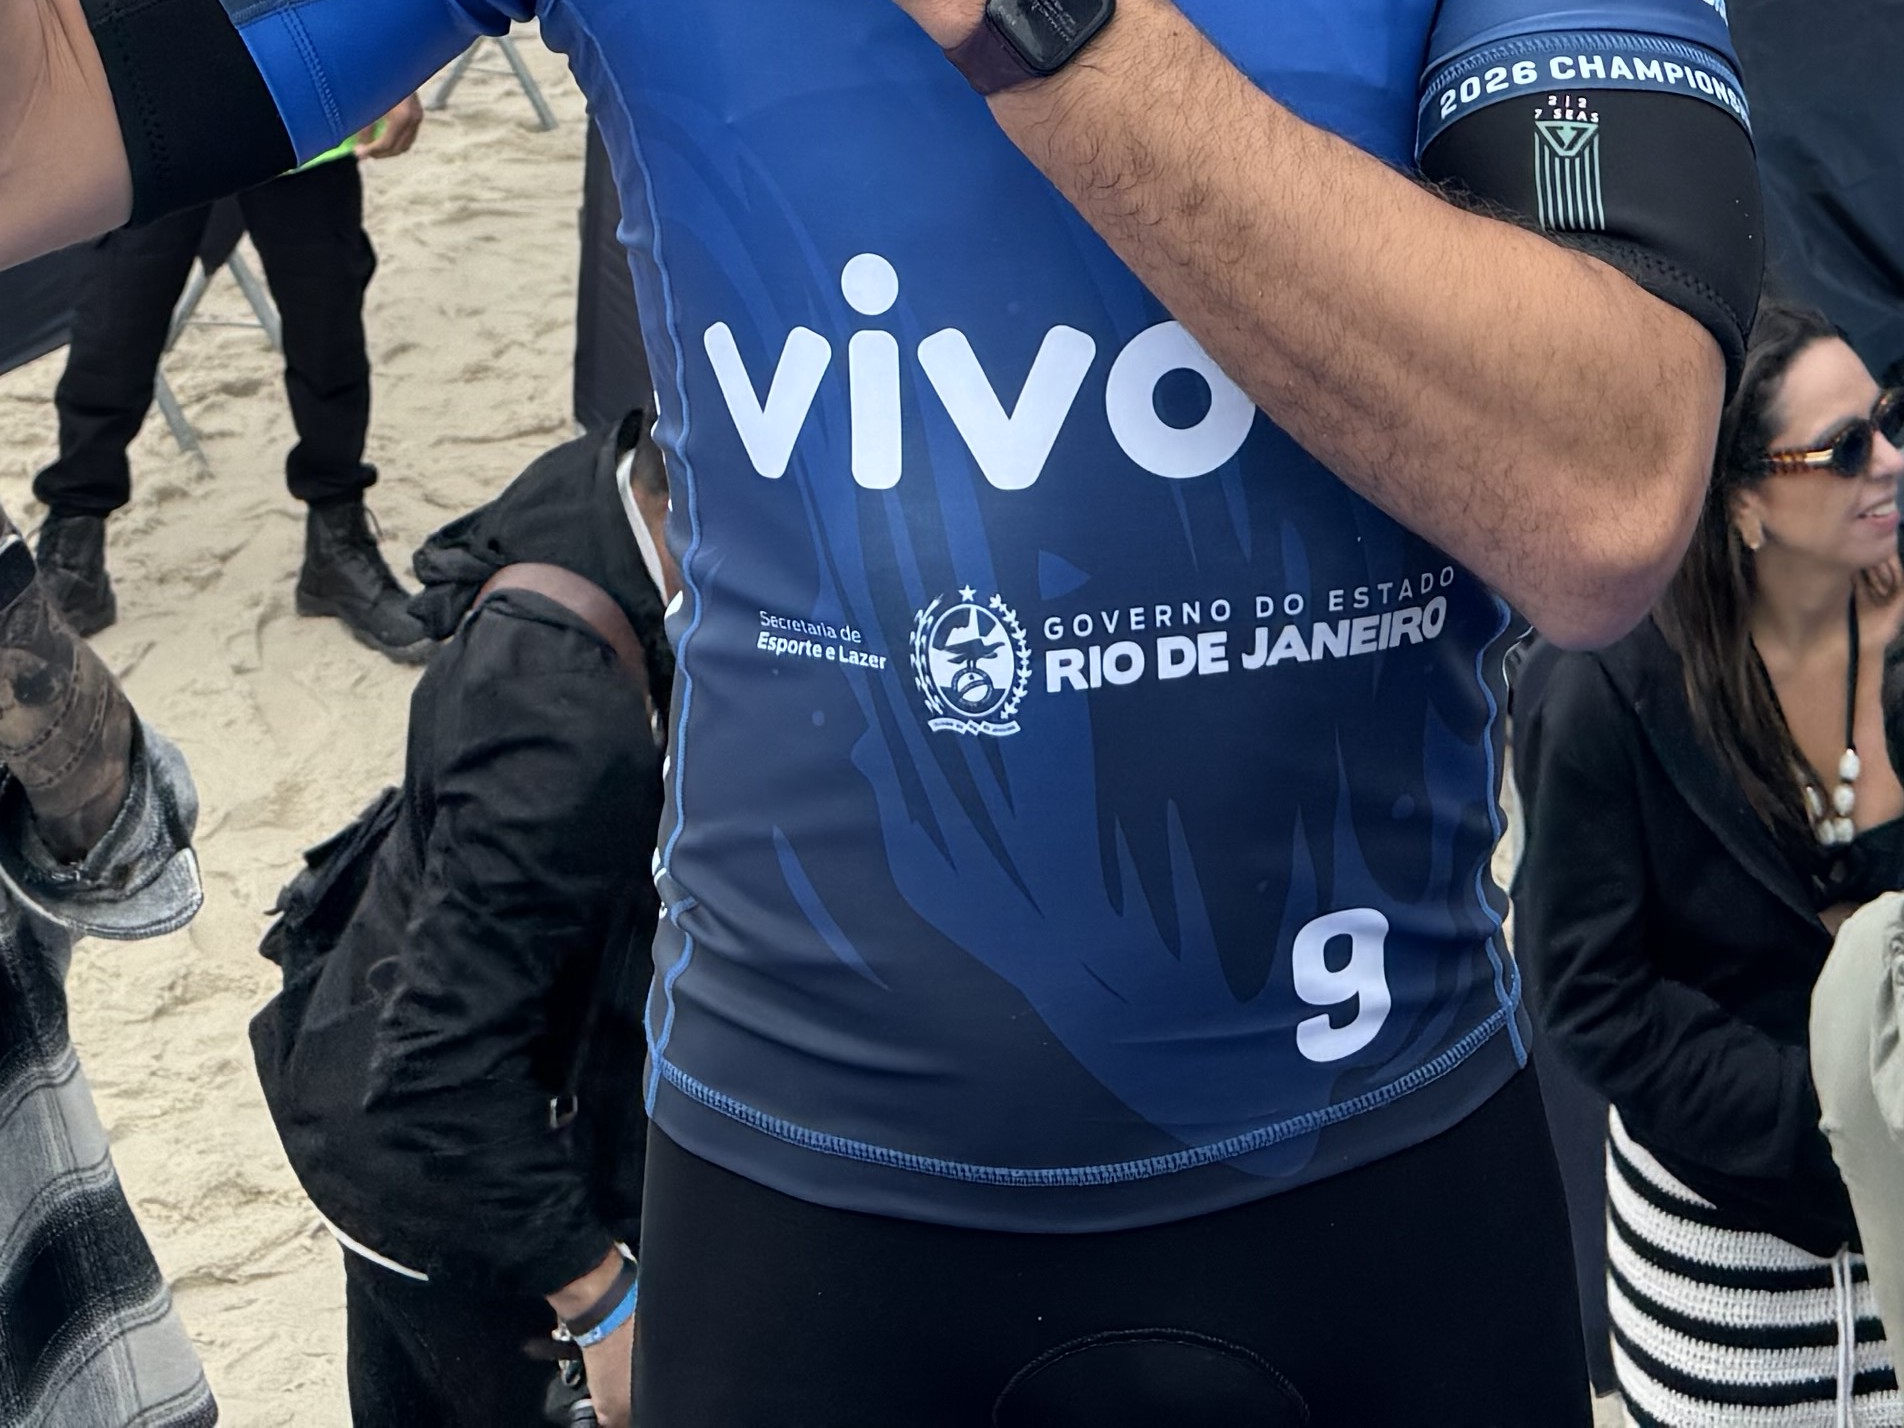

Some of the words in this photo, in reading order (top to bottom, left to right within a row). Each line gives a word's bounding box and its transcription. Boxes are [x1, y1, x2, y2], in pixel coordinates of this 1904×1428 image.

[1438, 60, 1539, 120] 2026
[1552, 108, 1600, 123] SEAS
[703, 252, 1258, 490] vivo
[759, 610, 837, 640] Secretaria
[840, 627, 863, 644] de
[1045, 598, 1231, 642] GOVERNO
[1256, 592, 1306, 620] DO
[1330, 565, 1456, 610] ESTADO
[756, 632, 822, 660] Esporte
[838, 642, 887, 671] Lazer
[1045, 644, 1145, 694] RIO
[1158, 627, 1230, 681] DE
[1241, 595, 1448, 670] JANEIRO
